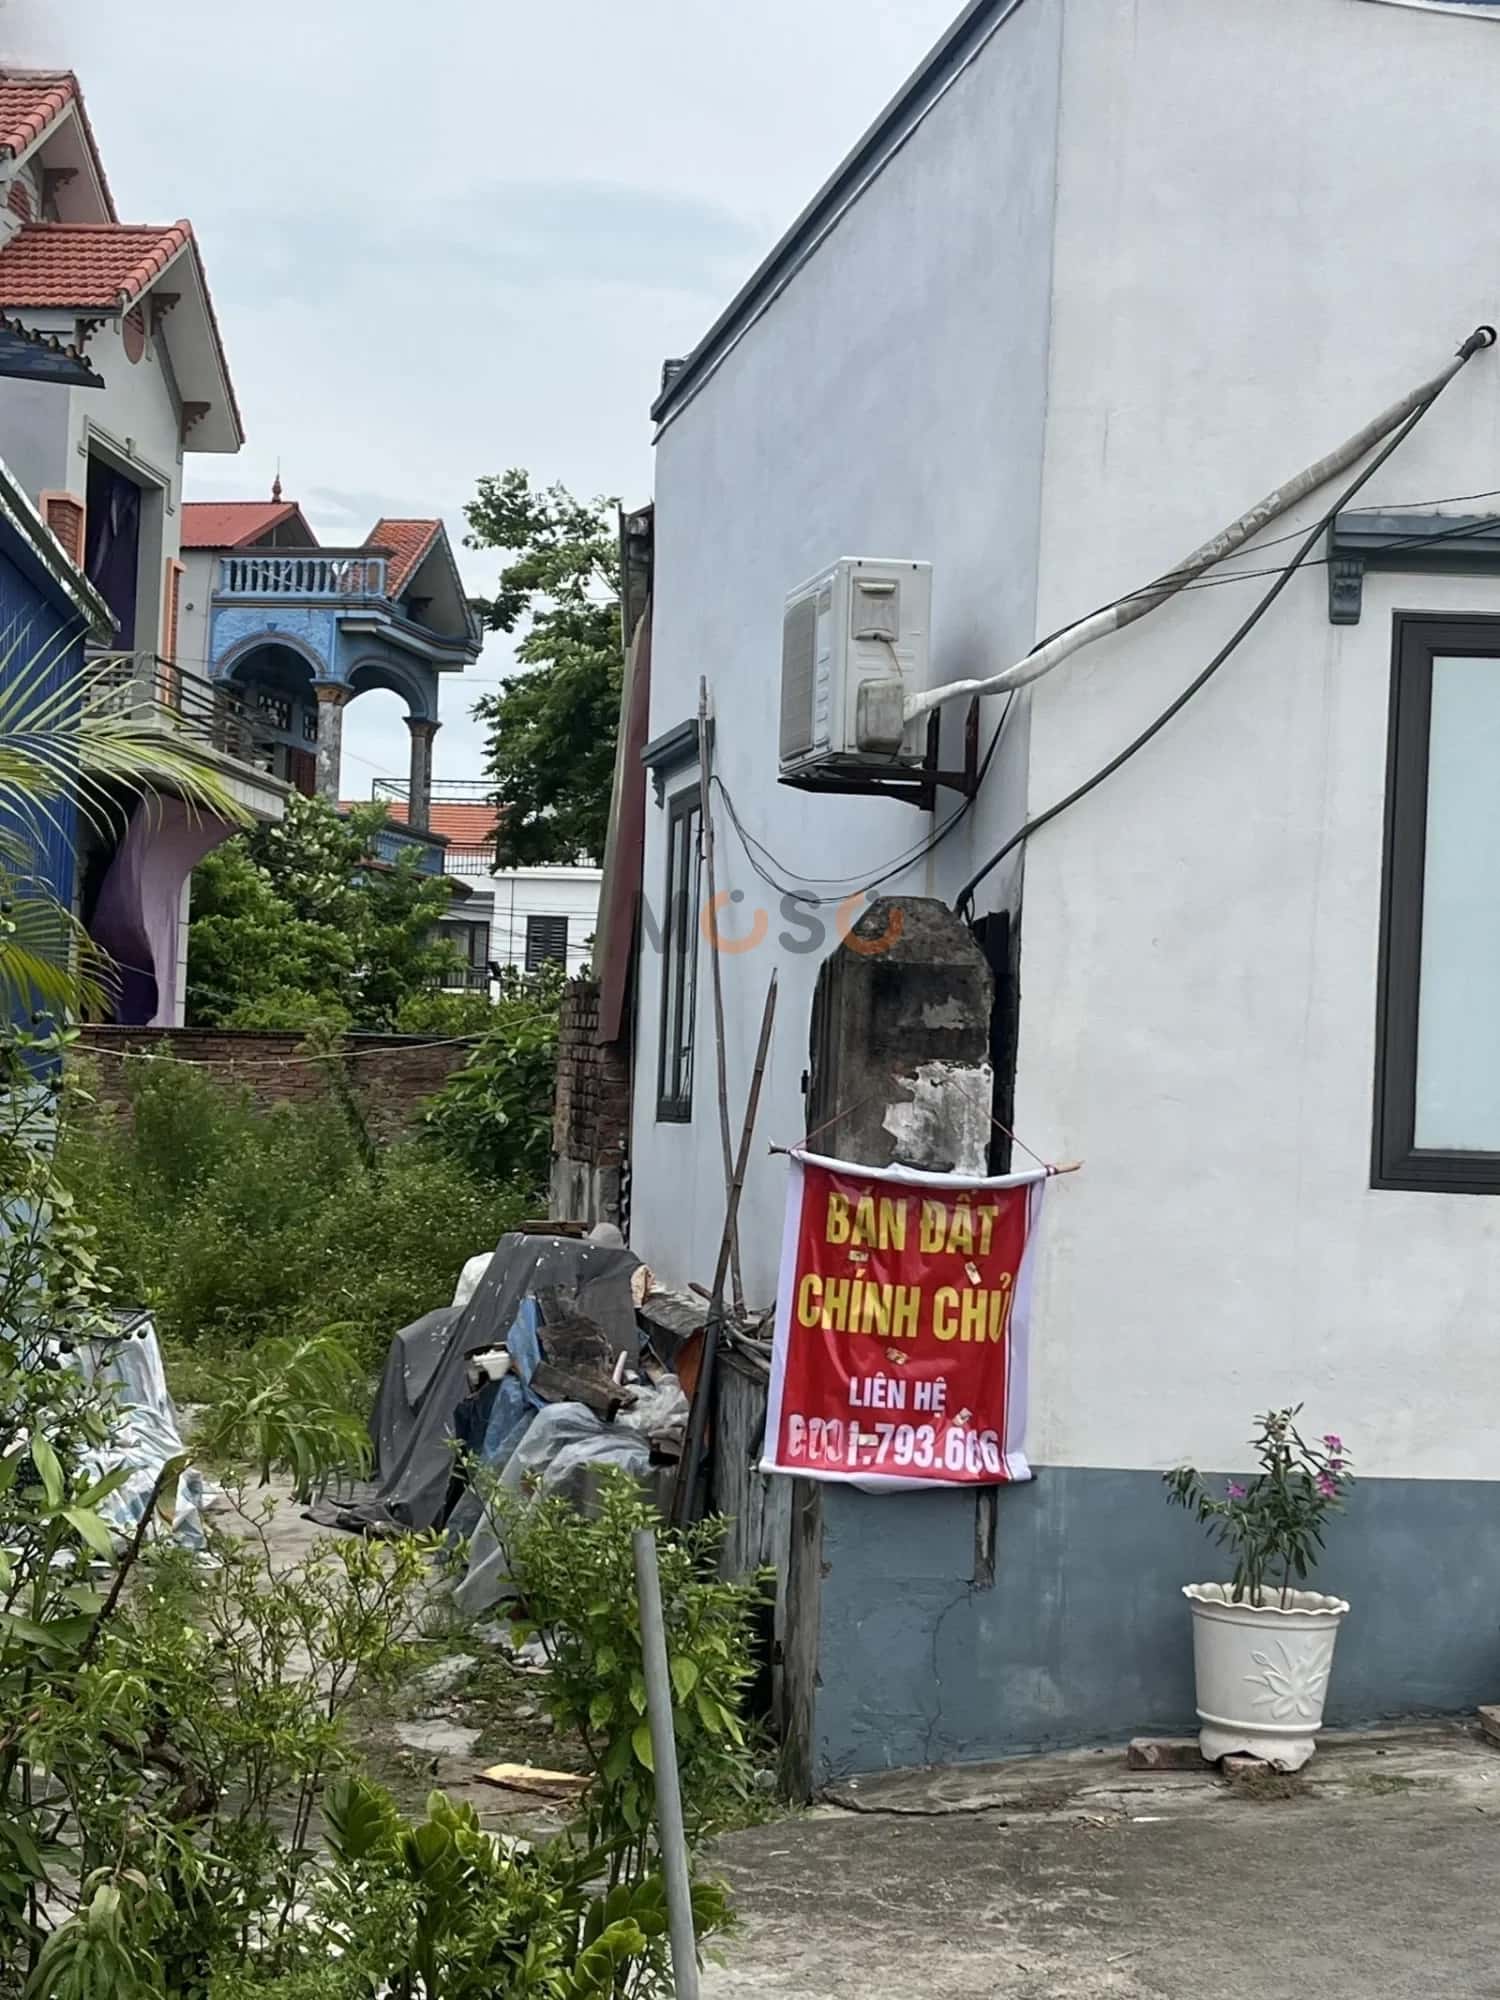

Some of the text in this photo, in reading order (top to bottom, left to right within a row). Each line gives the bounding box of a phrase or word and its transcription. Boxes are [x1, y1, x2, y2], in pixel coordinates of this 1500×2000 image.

[826, 1187, 999, 1255] BÁN ĐẤT
[797, 1268, 1011, 1343] CHÍNH CHỦ
[849, 1371, 947, 1418] LIÊN HỆ
